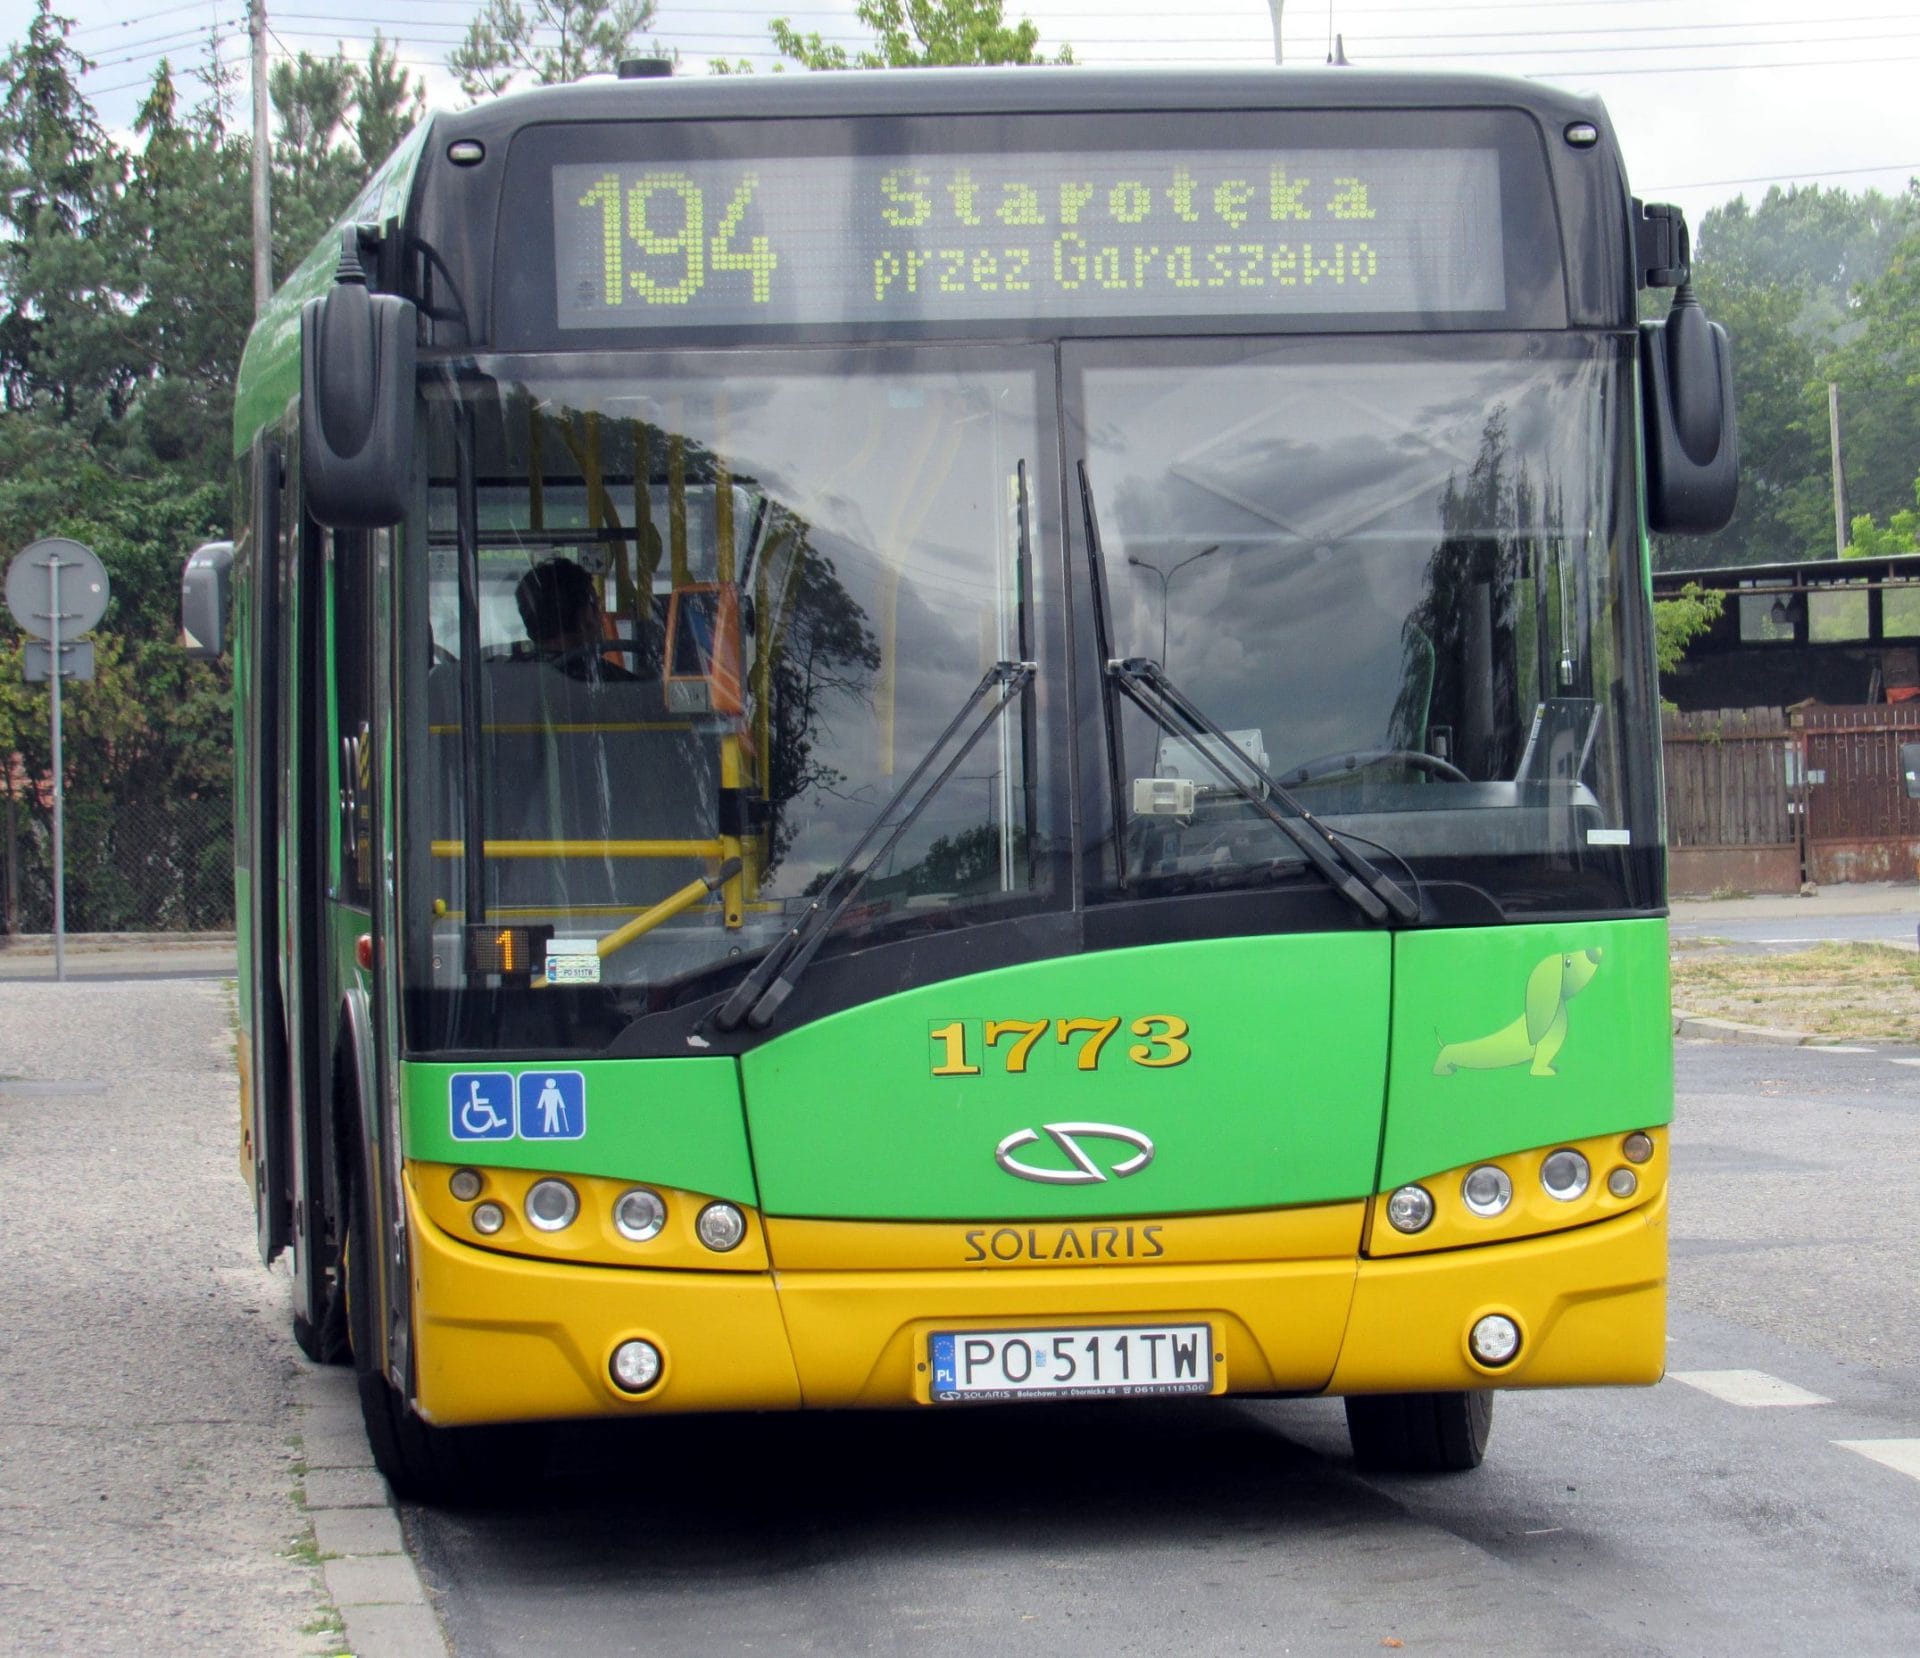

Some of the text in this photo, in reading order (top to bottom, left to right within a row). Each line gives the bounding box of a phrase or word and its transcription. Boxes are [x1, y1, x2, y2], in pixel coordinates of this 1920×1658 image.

[573, 173, 777, 304] 194
[874, 231, 1377, 301] przez Garaszewo
[496, 930, 513, 970] 1
[931, 1014, 1192, 1076] 1773
[964, 1225, 1165, 1262] SOLARIS
[936, 1369, 953, 1383] PL
[964, 1333, 1198, 1384] PO 511TW
[963, 1390, 1011, 1400] SOLARIS
[1134, 1385, 1154, 1394] 061
